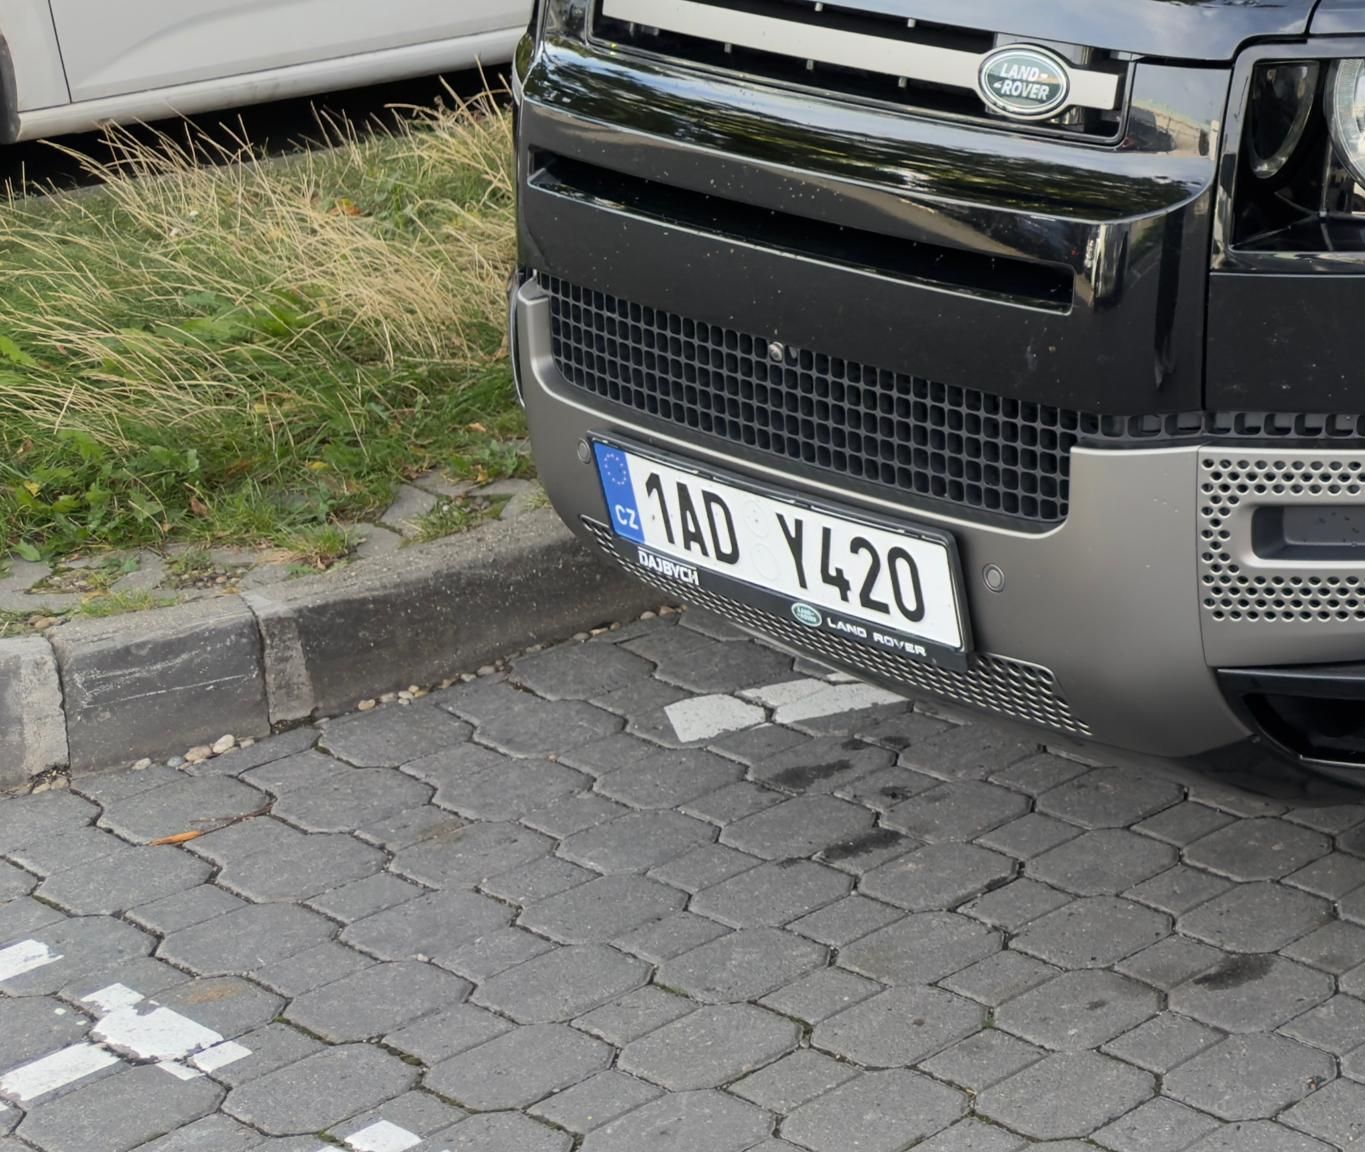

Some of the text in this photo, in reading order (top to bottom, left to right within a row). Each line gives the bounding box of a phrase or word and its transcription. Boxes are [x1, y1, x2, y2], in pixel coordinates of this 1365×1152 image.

[1000, 63, 1039, 81] LAND
[1001, 80, 1049, 100] ROVER
[615, 504, 640, 531] CZ
[645, 472, 925, 623] 1AD Y420
[638, 548, 699, 586] DAJBYCH
[827, 617, 927, 656] LAND ROVER
